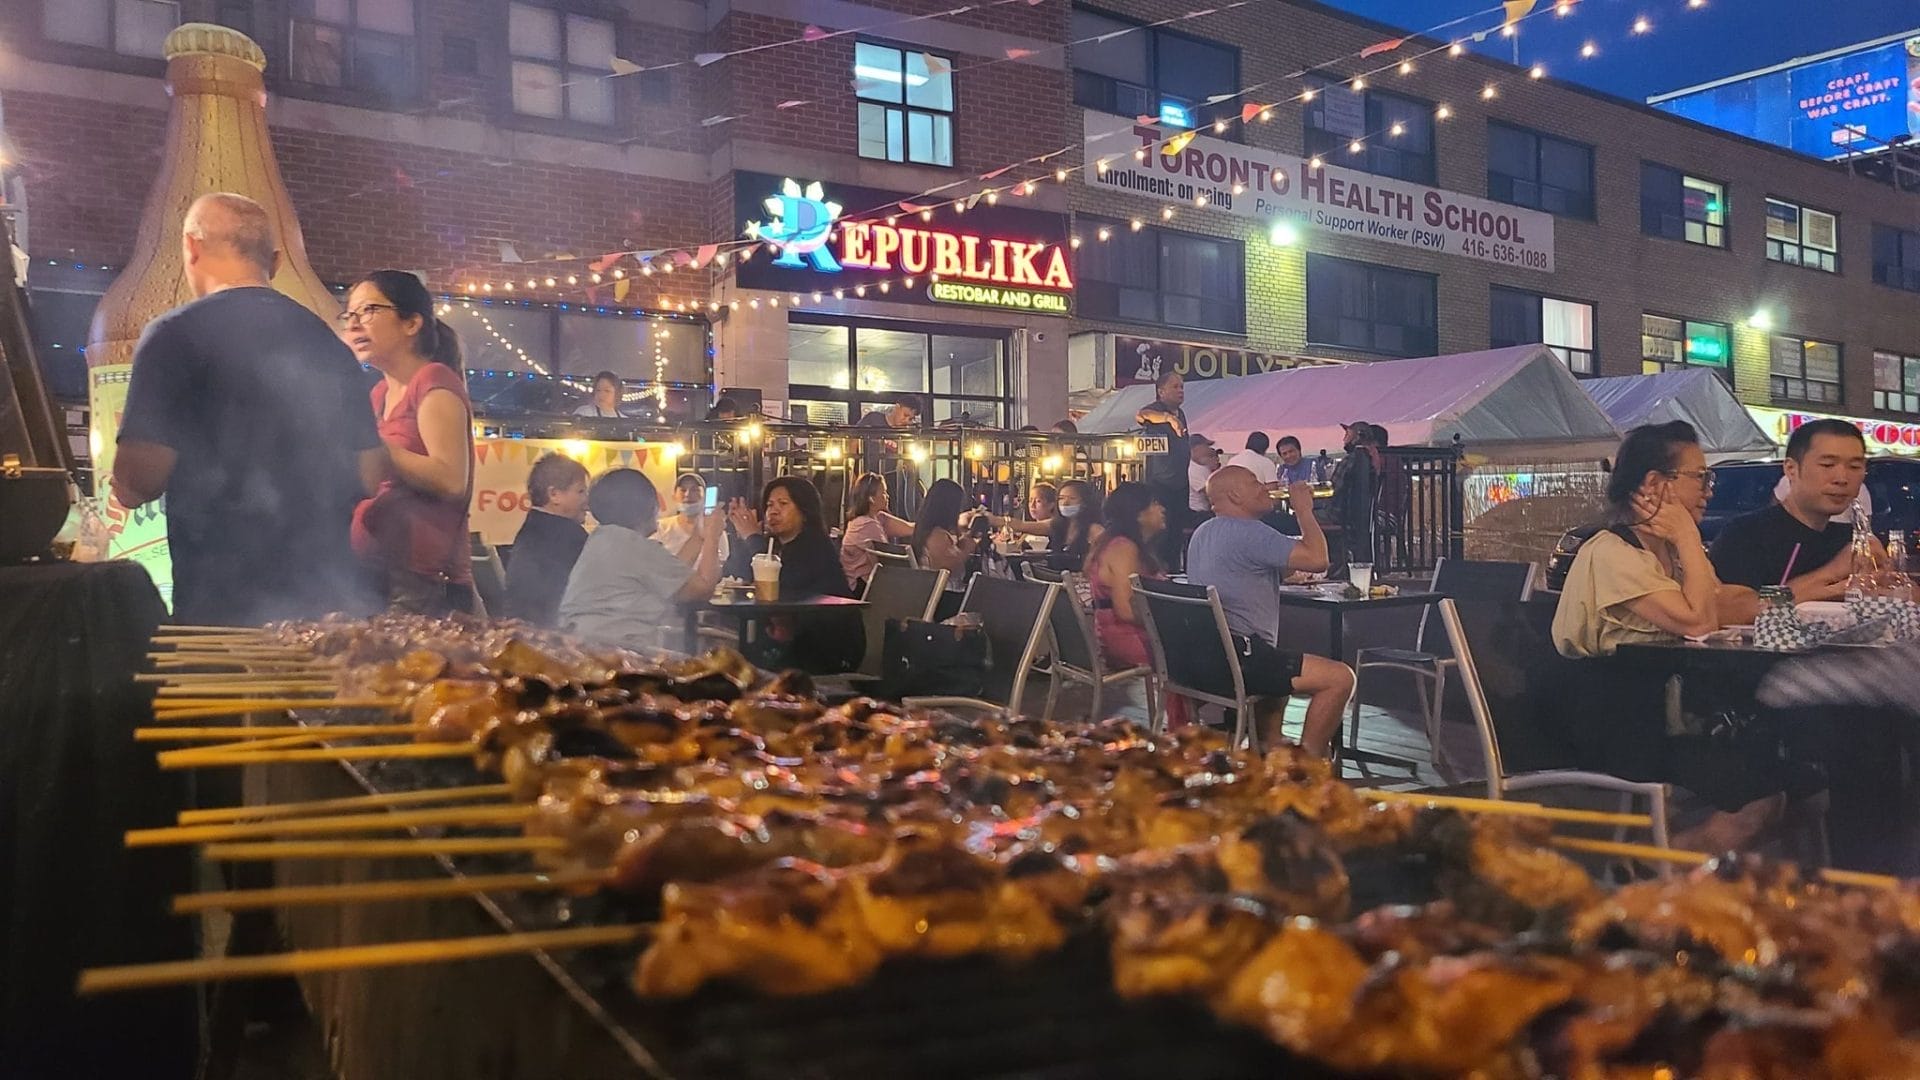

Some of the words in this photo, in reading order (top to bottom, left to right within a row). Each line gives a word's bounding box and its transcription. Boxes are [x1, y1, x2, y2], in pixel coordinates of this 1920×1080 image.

[1799, 88, 1851, 109] BEFORE
[1856, 77, 1900, 95] CRAFT
[1827, 72, 1870, 90] CRAFT
[1807, 104, 1839, 119] WAS
[1842, 93, 1891, 110] CRAFT.
[1133, 125, 1291, 196] TORONTO
[1301, 164, 1413, 221] HEALTH
[1424, 191, 1525, 243] SCHOOL
[1178, 183, 1194, 200] on
[1256, 199, 1312, 223] Personal
[1316, 210, 1364, 232] Support
[1367, 220, 1408, 241] Worker
[1412, 228, 1445, 250] (PSW)
[764, 190, 1074, 288] REPUBLIKA
[934, 283, 1000, 305] RESTOBAR
[1001, 291, 1031, 308] AND
[1033, 294, 1067, 311] GRILL
[1137, 438, 1166, 452] OPEN
